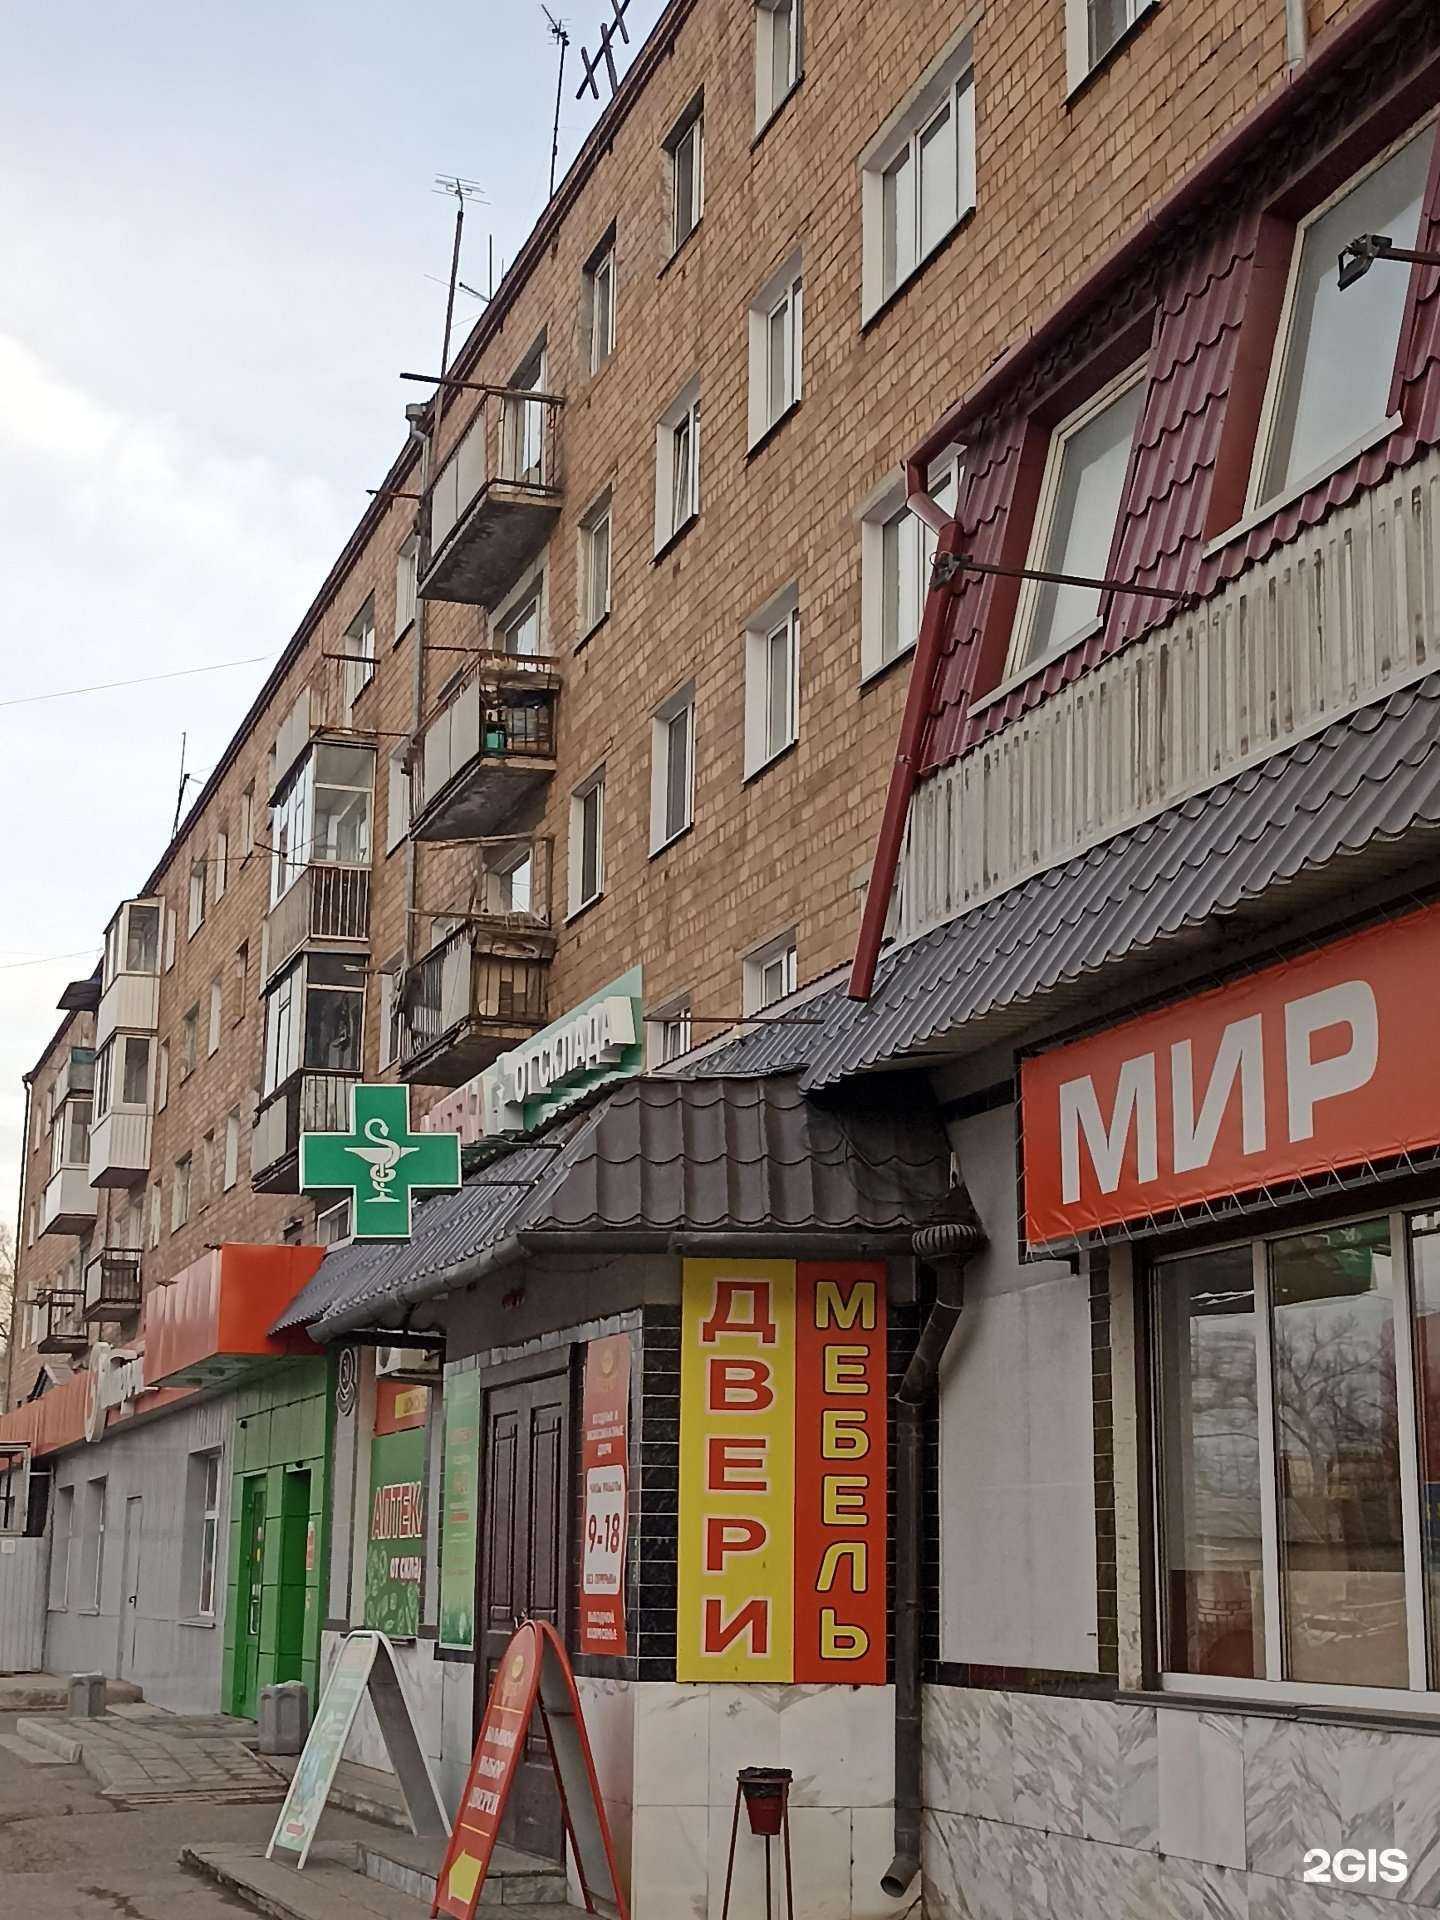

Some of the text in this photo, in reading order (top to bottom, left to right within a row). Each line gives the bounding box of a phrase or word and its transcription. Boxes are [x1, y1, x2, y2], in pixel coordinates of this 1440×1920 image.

[513, 998, 628, 1103] ОТ СКЛАДА
[1059, 979, 1379, 1205] МИР
[371, 1481, 424, 1540] АПТЕК
[588, 1512, 620, 1553] 9-18
[699, 1278, 777, 1657] ДВЕРИ
[815, 1280, 878, 1659] МЕБЕЛЬ
